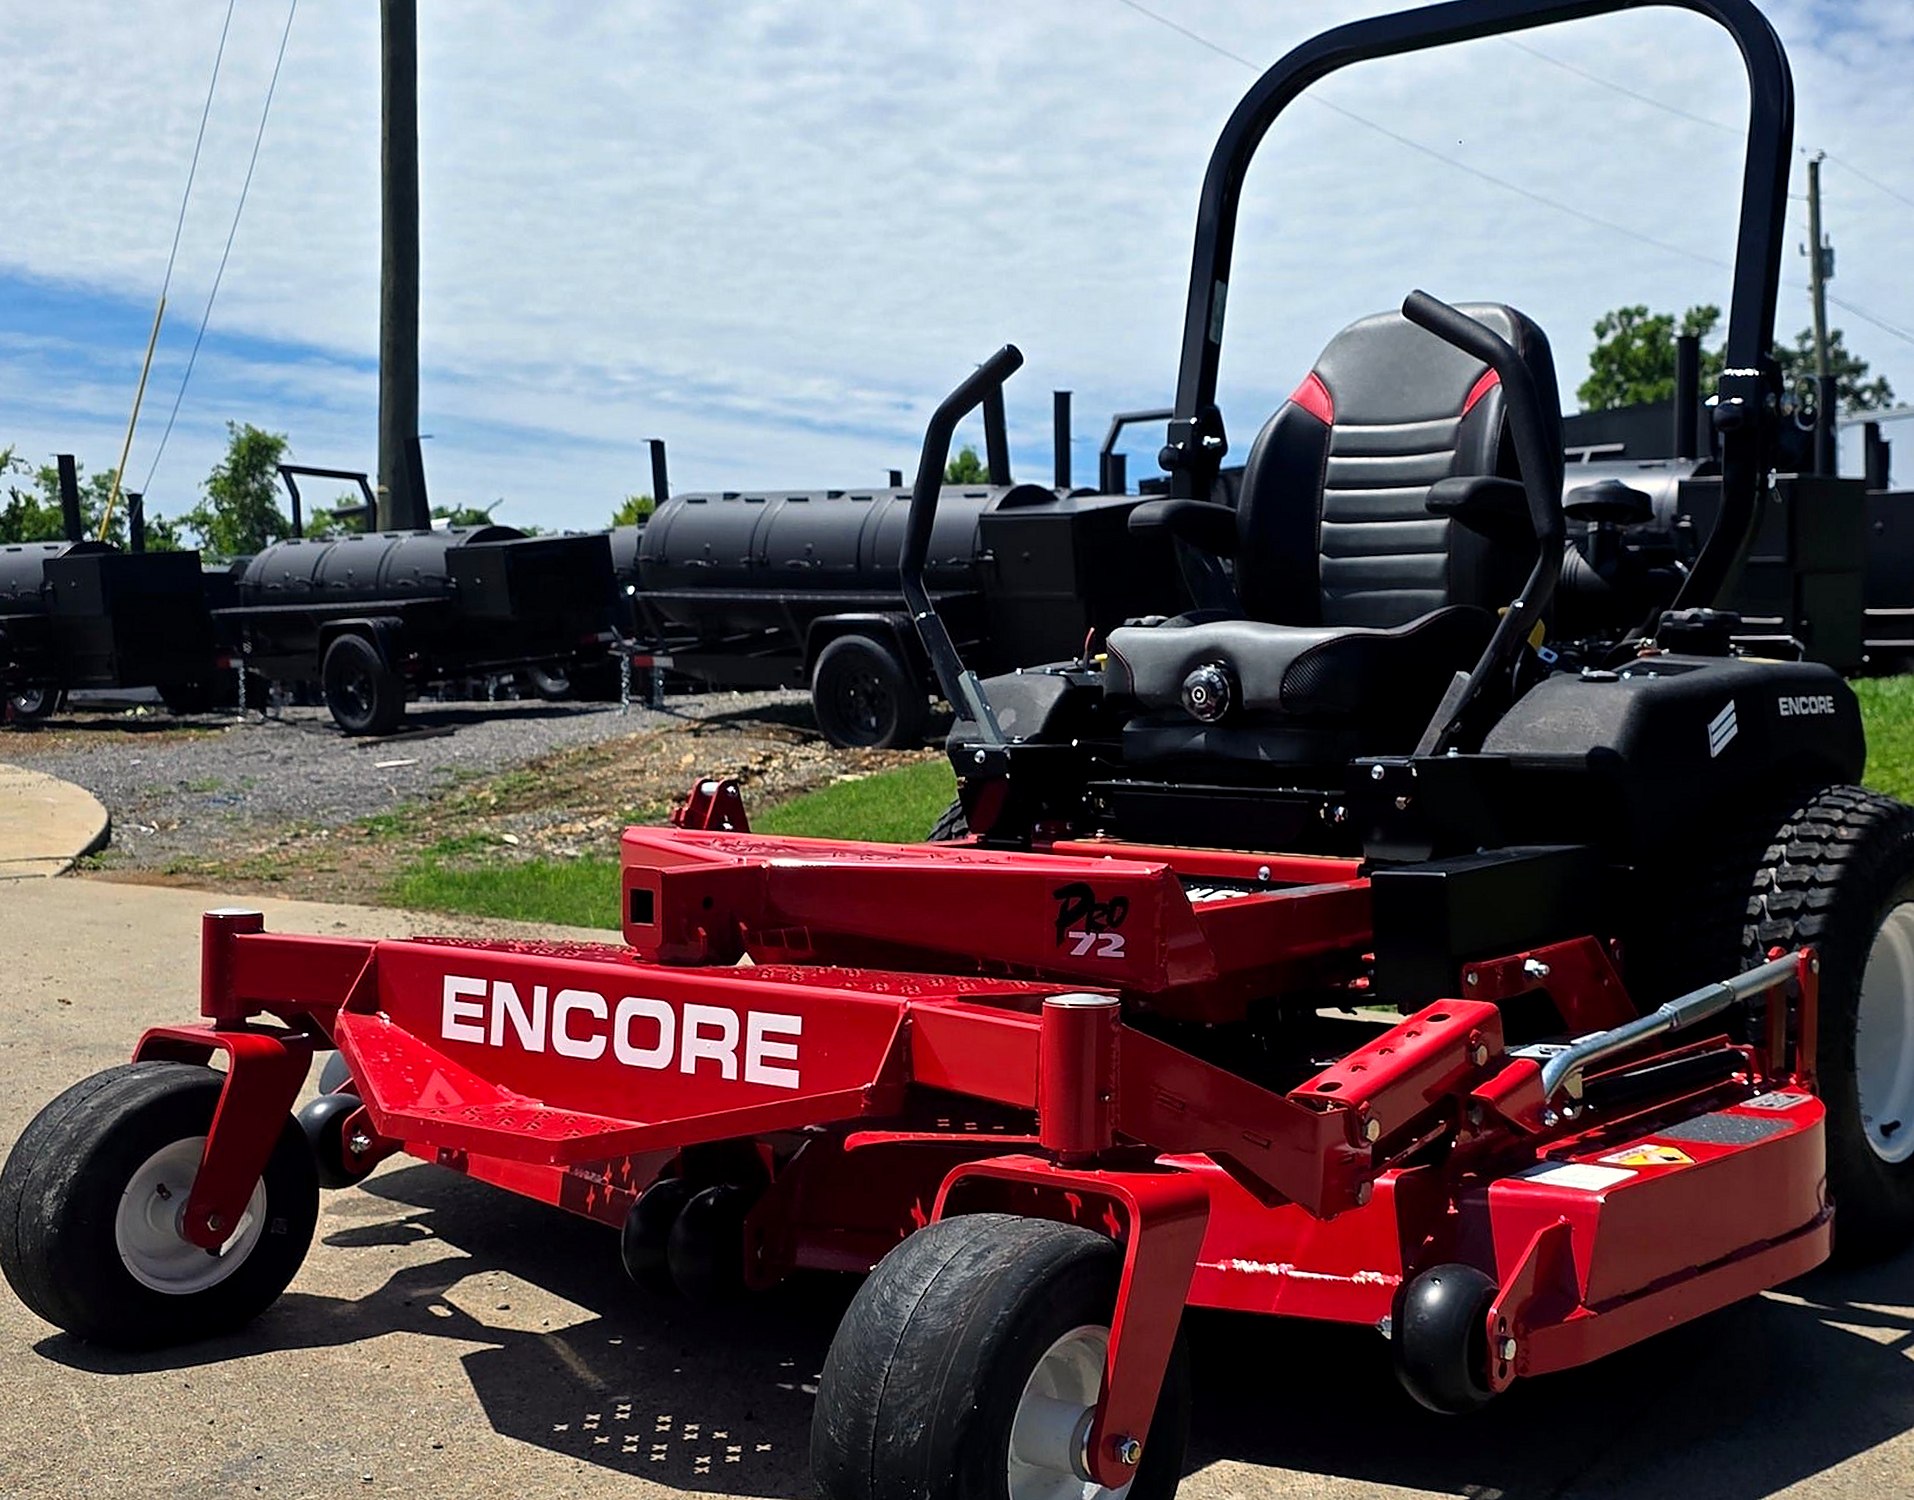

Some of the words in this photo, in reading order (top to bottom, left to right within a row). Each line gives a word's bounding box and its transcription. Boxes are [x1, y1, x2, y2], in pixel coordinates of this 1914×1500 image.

[1778, 695, 1836, 717] ENCORE
[1068, 930, 1126, 958] 72
[440, 974, 803, 1090] ENCORE
